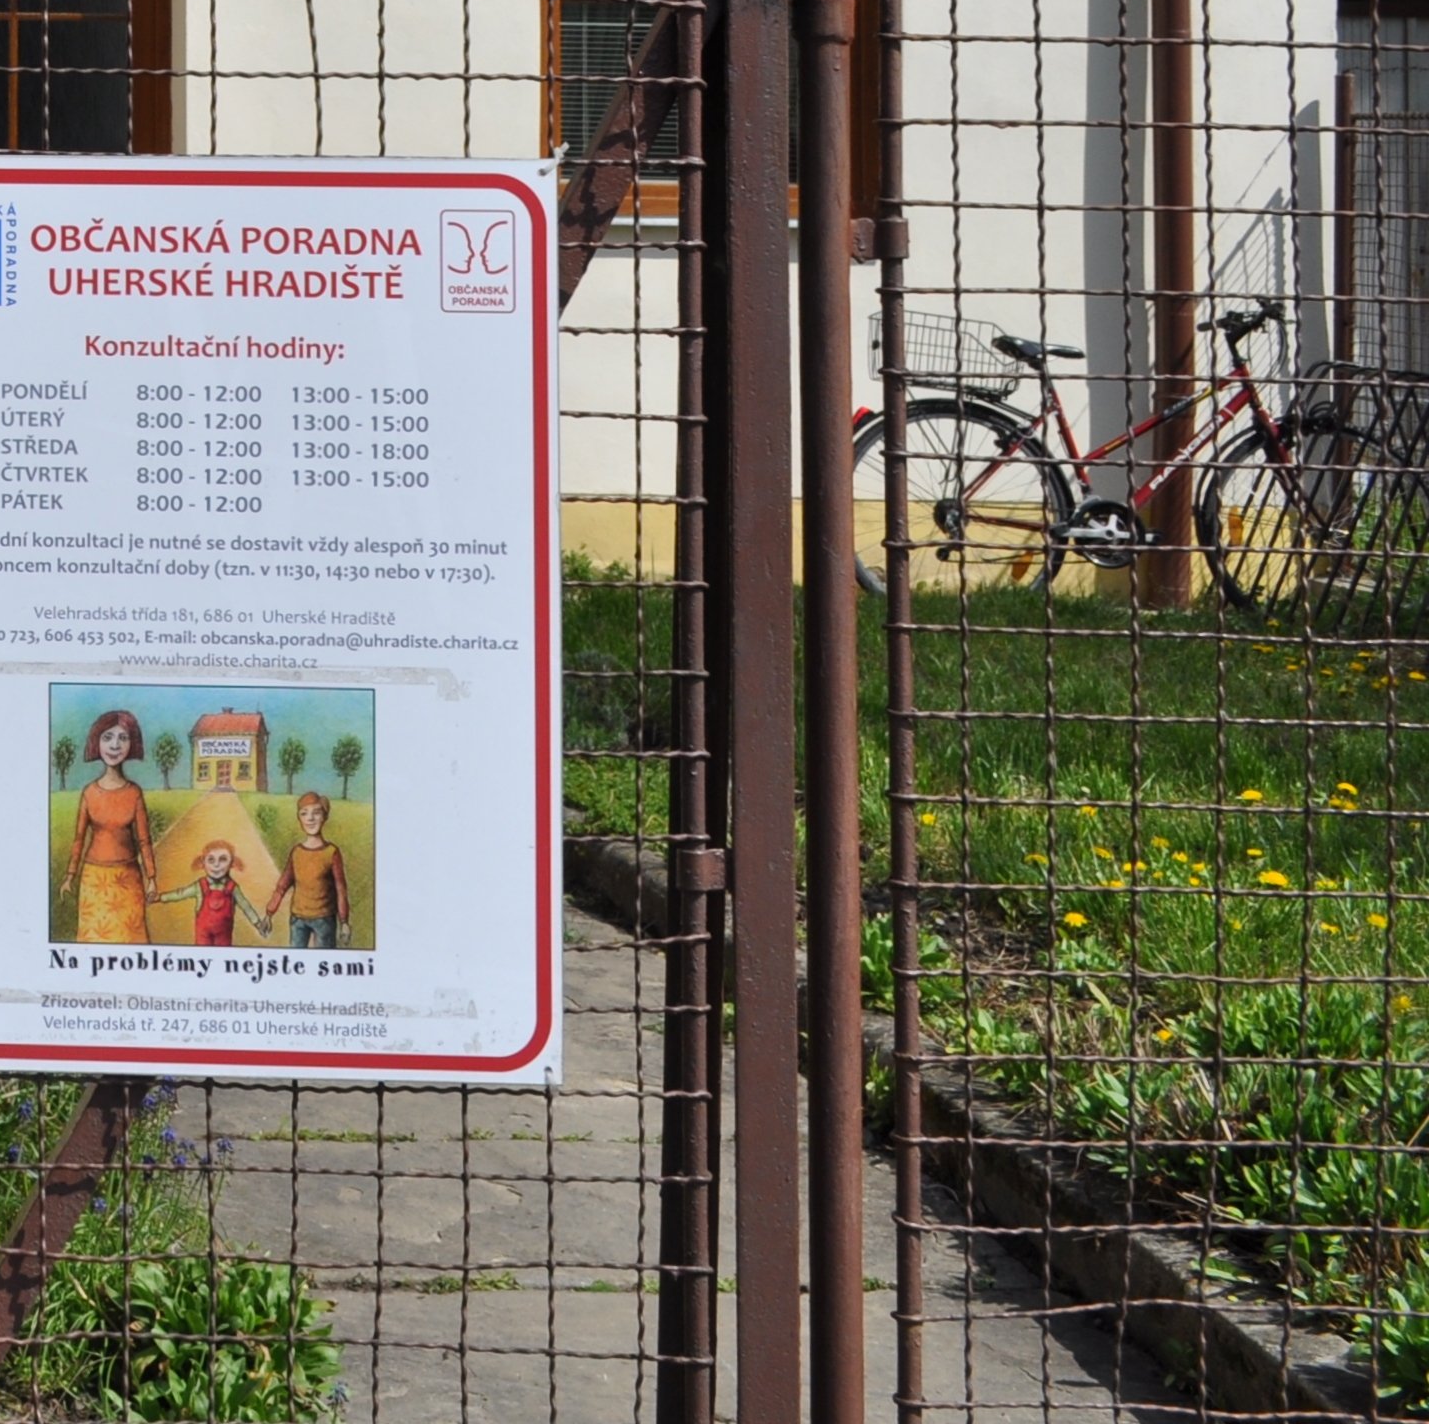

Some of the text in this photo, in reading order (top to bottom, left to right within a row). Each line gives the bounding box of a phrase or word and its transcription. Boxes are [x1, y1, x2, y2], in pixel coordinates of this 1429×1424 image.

[31, 219, 421, 255] OBČANSKÁ PORADNA
[6, 220, 16, 306] PORADNA
[50, 263, 403, 298] UHERSKÉ HRADIŠTĚ
[448, 285, 508, 295] OBČANSKÁ
[452, 297, 504, 306] PORADNA
[86, 335, 344, 365] Konzultační hodiny:
[2, 381, 87, 400] PONDĚLÍ
[137, 385, 183, 401] 8:00
[205, 386, 261, 402] 12:00
[293, 387, 349, 403] 13:00
[371, 388, 428, 405] 15:00
[2, 407, 64, 427] ÚTERÝ
[137, 412, 183, 428] 8:00
[205, 413, 261, 430] 12:00
[293, 415, 350, 431] 13:00
[371, 416, 428, 432] 15:00
[1, 435, 78, 454] STŘEDA
[137, 440, 183, 456] 8:00
[205, 441, 261, 457] 12:00
[293, 442, 350, 459] 13:00
[372, 444, 429, 460] 18:00
[1, 463, 88, 482] ČTVRTEK
[137, 467, 183, 484] 8:00
[205, 469, 262, 485] 12:00
[293, 470, 350, 486] 13:00
[372, 471, 429, 488] 15:00
[2, 490, 62, 509] PÁTEK
[137, 495, 183, 511] 8:00
[205, 496, 262, 513] 12:00
[33, 532, 123, 548] konzultaci
[129, 534, 144, 552] je
[150, 535, 201, 550] nutné
[207, 539, 225, 550] se
[231, 535, 303, 551] dostavit
[308, 537, 349, 556] vždy
[354, 537, 423, 557] alespoň
[429, 542, 449, 557] 30
[455, 539, 507, 555] minut
[57, 558, 160, 574] konzultační
[165, 559, 209, 579] doby
[215, 560, 255, 579] (tzn.
[260, 566, 270, 576] v
[276, 565, 320, 580] 11:30,
[326, 566, 369, 581] 14:30
[375, 563, 420, 579] nebo
[425, 569, 435, 579] v
[440, 564, 495, 584] 17:30).
[34, 606, 127, 620] Velehradská
[132, 608, 167, 621] třída
[173, 608, 198, 624] 181,
[203, 609, 233, 622] 686
[263, 609, 326, 624] Uherské
[331, 611, 395, 625] Hradiště
[10, 630, 40, 644] 723,
[45, 629, 73, 641] 606
[77, 632, 104, 645] 453
[109, 632, 140, 645] 502,
[145, 630, 196, 644] E-mail:
[201, 631, 518, 651] obcanska.poradna@uhradiste.charita.cz
[119, 653, 318, 669] www.uhradiste.charita.cz
[50, 949, 373, 982] Na problémy nejste sami
[41, 994, 388, 1018] Zřizovatel: Oblastní charita Uherské Hradiště,
[43, 1016, 387, 1037] Velehradská tř. 247, 686 01 Uherské Hradiště
